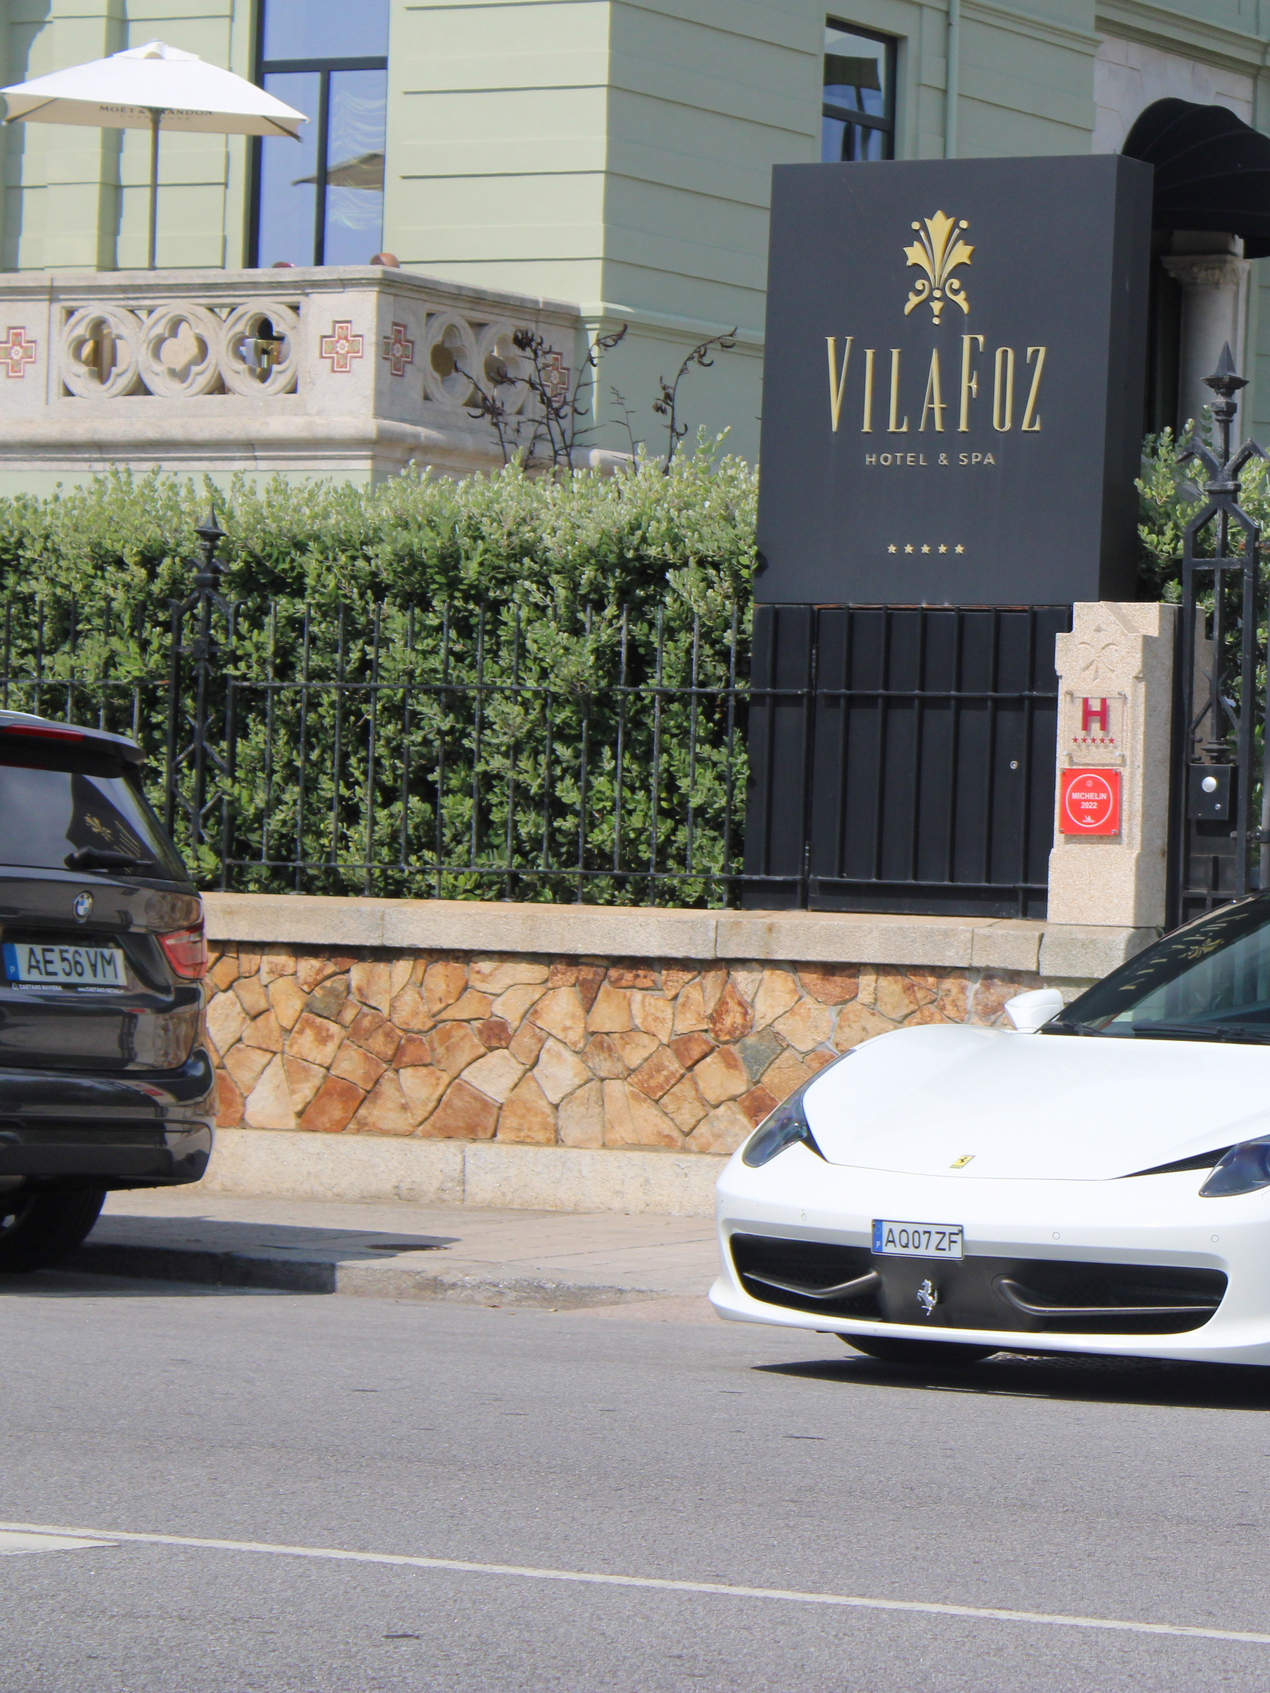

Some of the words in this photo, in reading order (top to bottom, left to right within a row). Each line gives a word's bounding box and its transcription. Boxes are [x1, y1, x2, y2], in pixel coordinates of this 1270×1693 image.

[865, 452, 928, 466] HOTEL
[938, 452, 949, 466] &
[958, 452, 996, 466] SPA
[1081, 697, 1107, 731] H
[1071, 792, 1107, 800] MICHELIN
[1080, 801, 1098, 809] 2022
[884, 1228, 960, 1252] AQ07ZF
